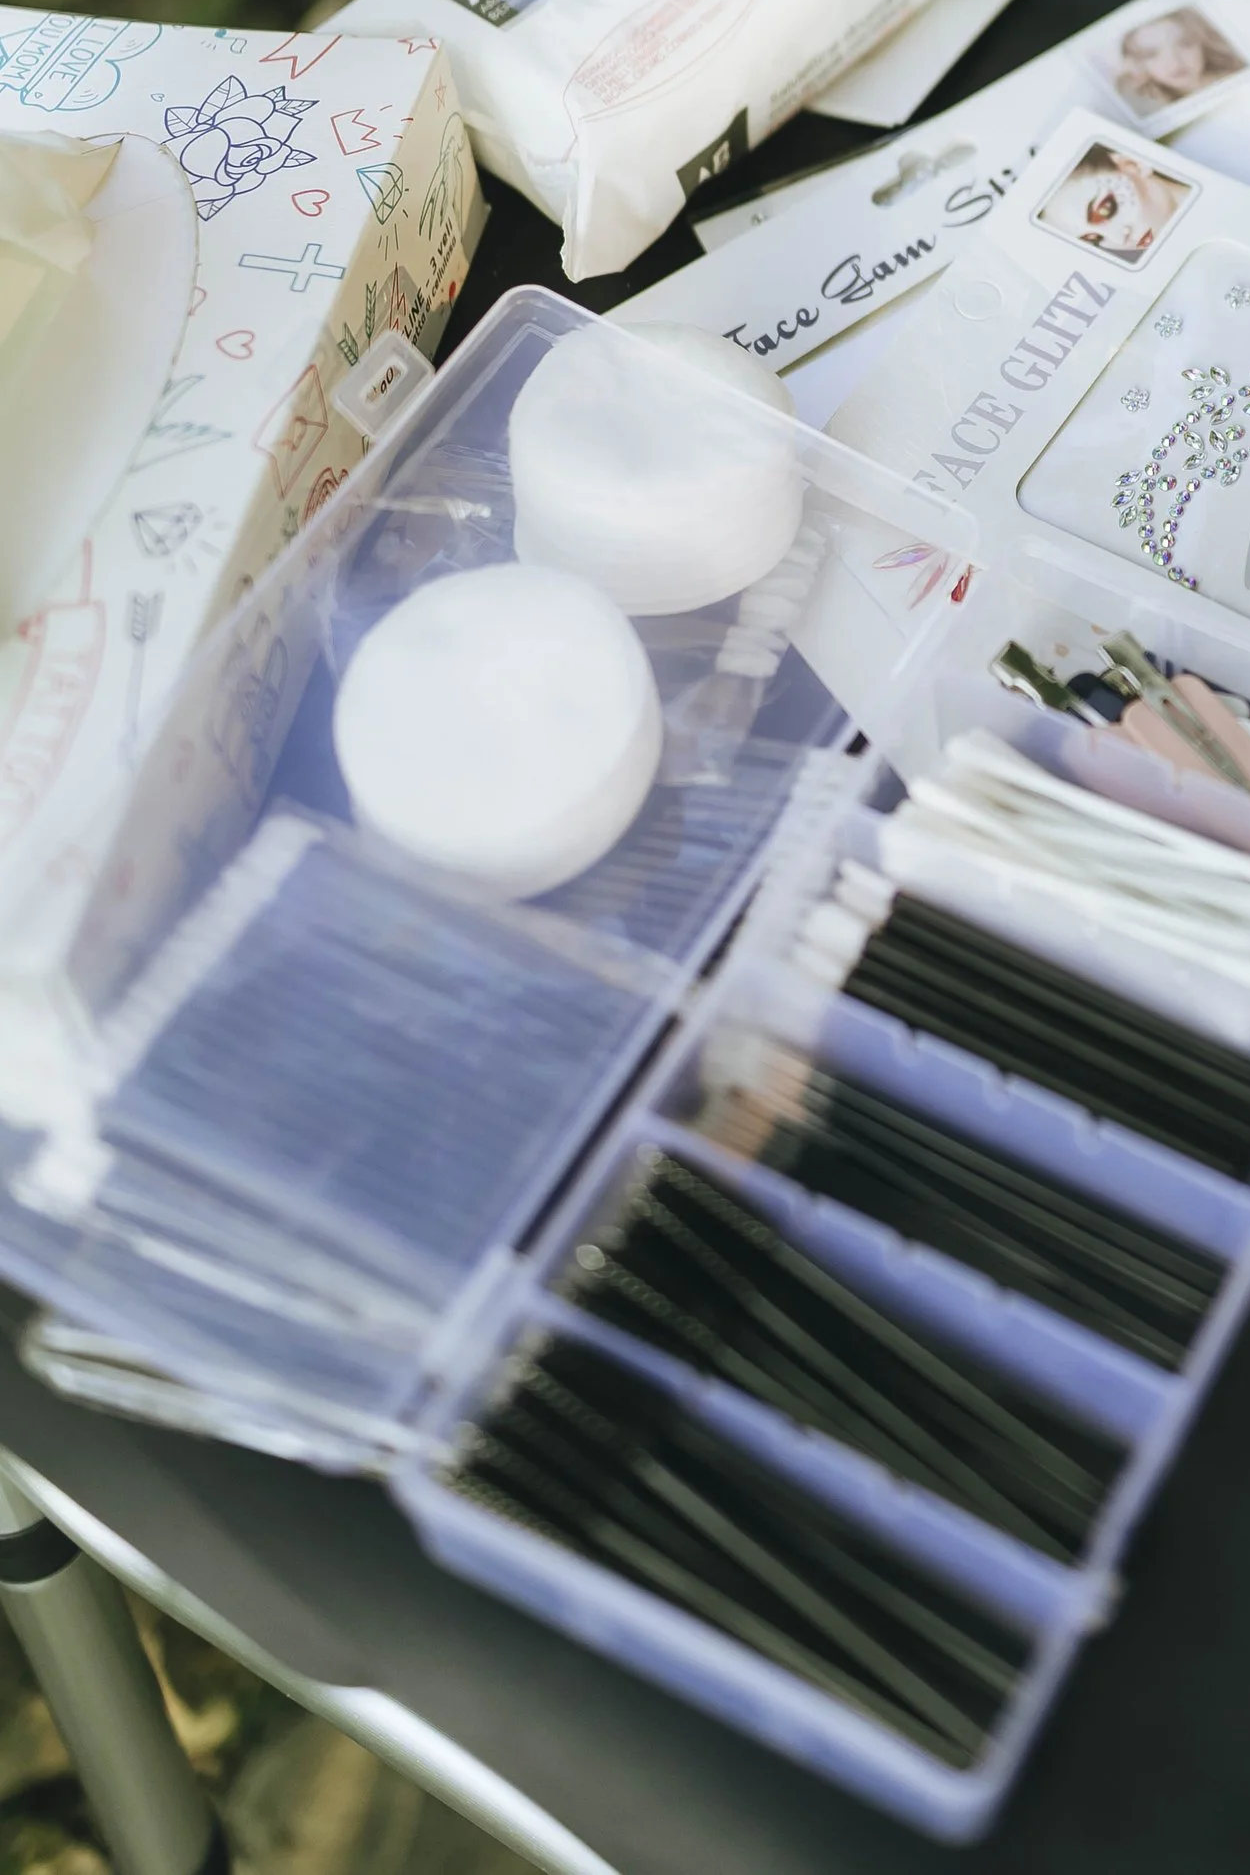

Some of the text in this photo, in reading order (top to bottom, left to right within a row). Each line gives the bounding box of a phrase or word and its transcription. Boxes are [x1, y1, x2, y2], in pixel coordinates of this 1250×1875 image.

[2, 15, 76, 81] OU MOM
[49, 38, 105, 84] LOVE
[402, 286, 425, 341] LINE
[429, 256, 438, 274] 3
[431, 236, 457, 298] cellulosa
[722, 306, 820, 356] Face
[902, 270, 1117, 513] FACE GLITZ
